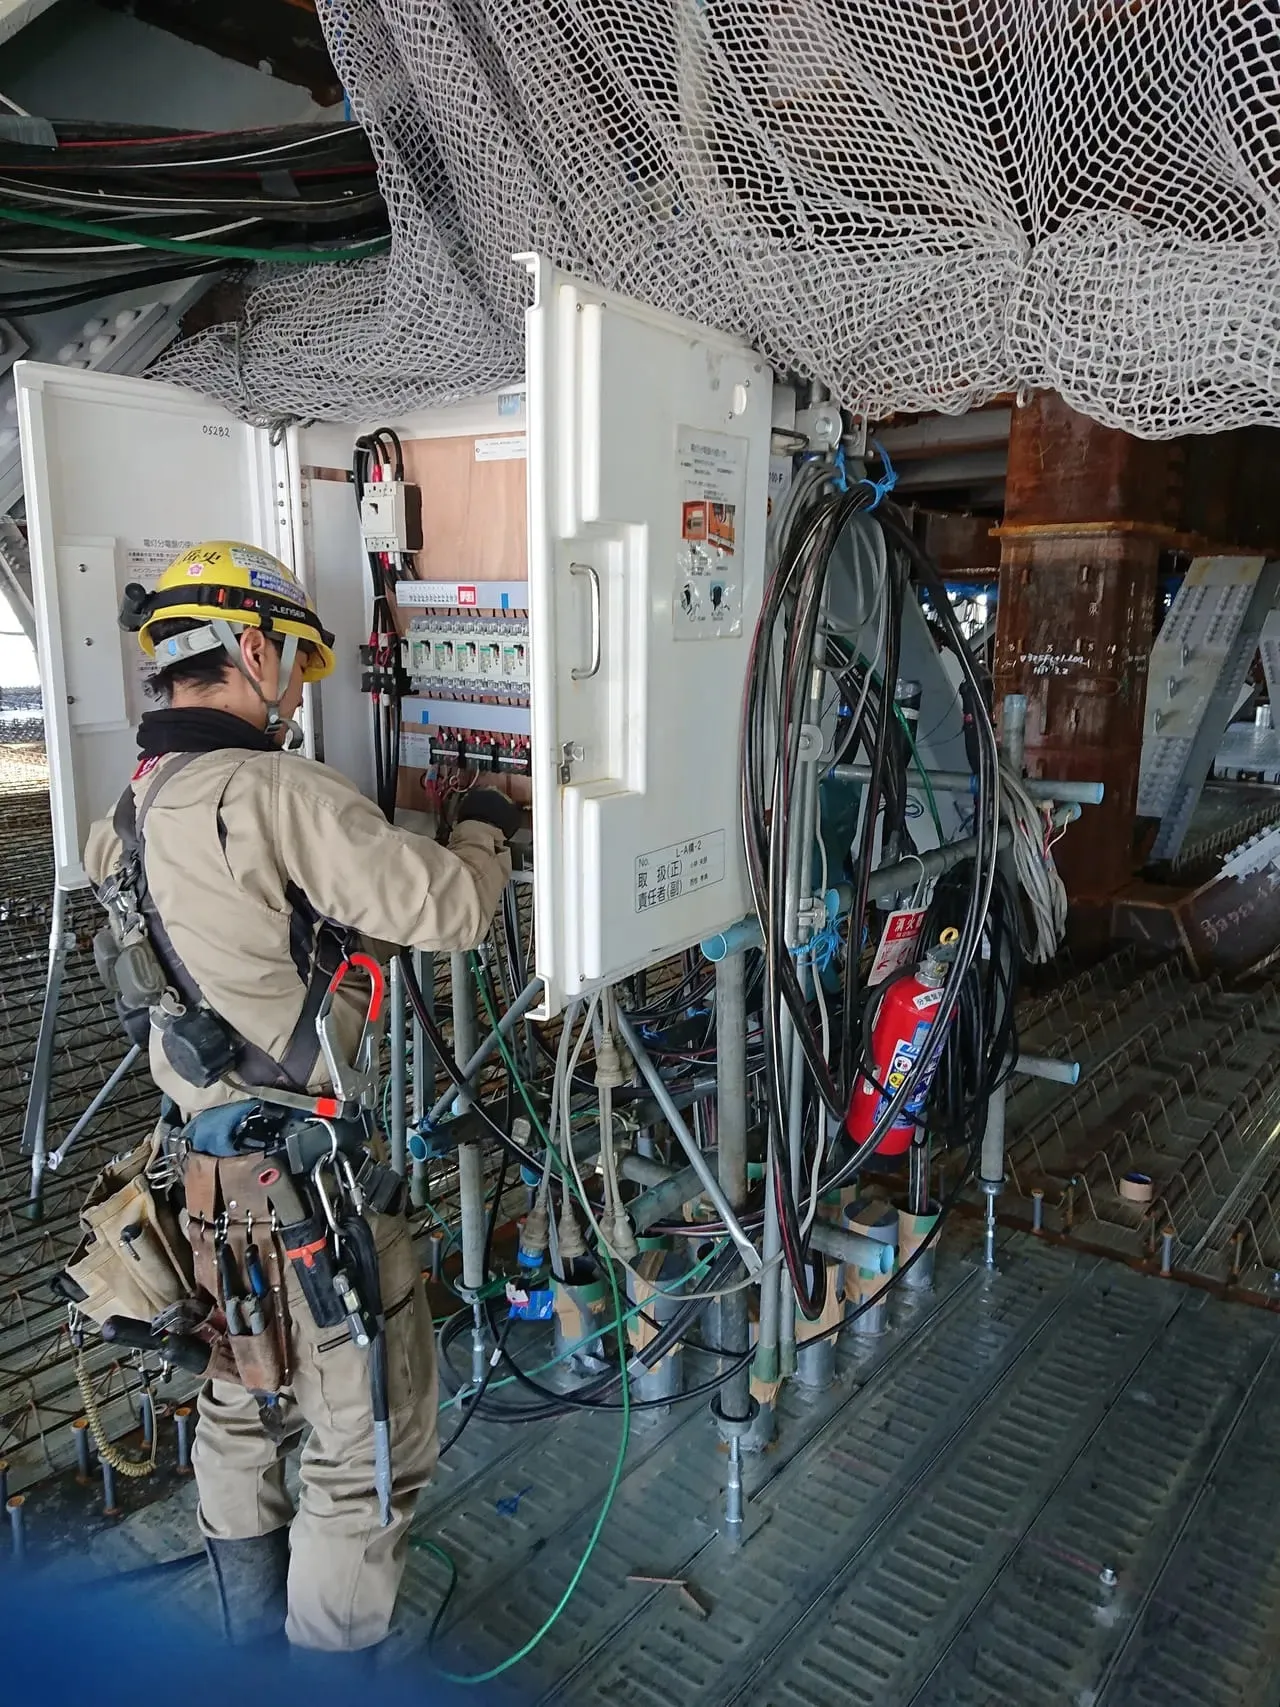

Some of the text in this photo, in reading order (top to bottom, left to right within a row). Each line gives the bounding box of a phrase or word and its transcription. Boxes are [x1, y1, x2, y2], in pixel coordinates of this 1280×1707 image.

[202, 425, 230, 437] 05282
[638, 879, 683, 910] 責任者(副)
